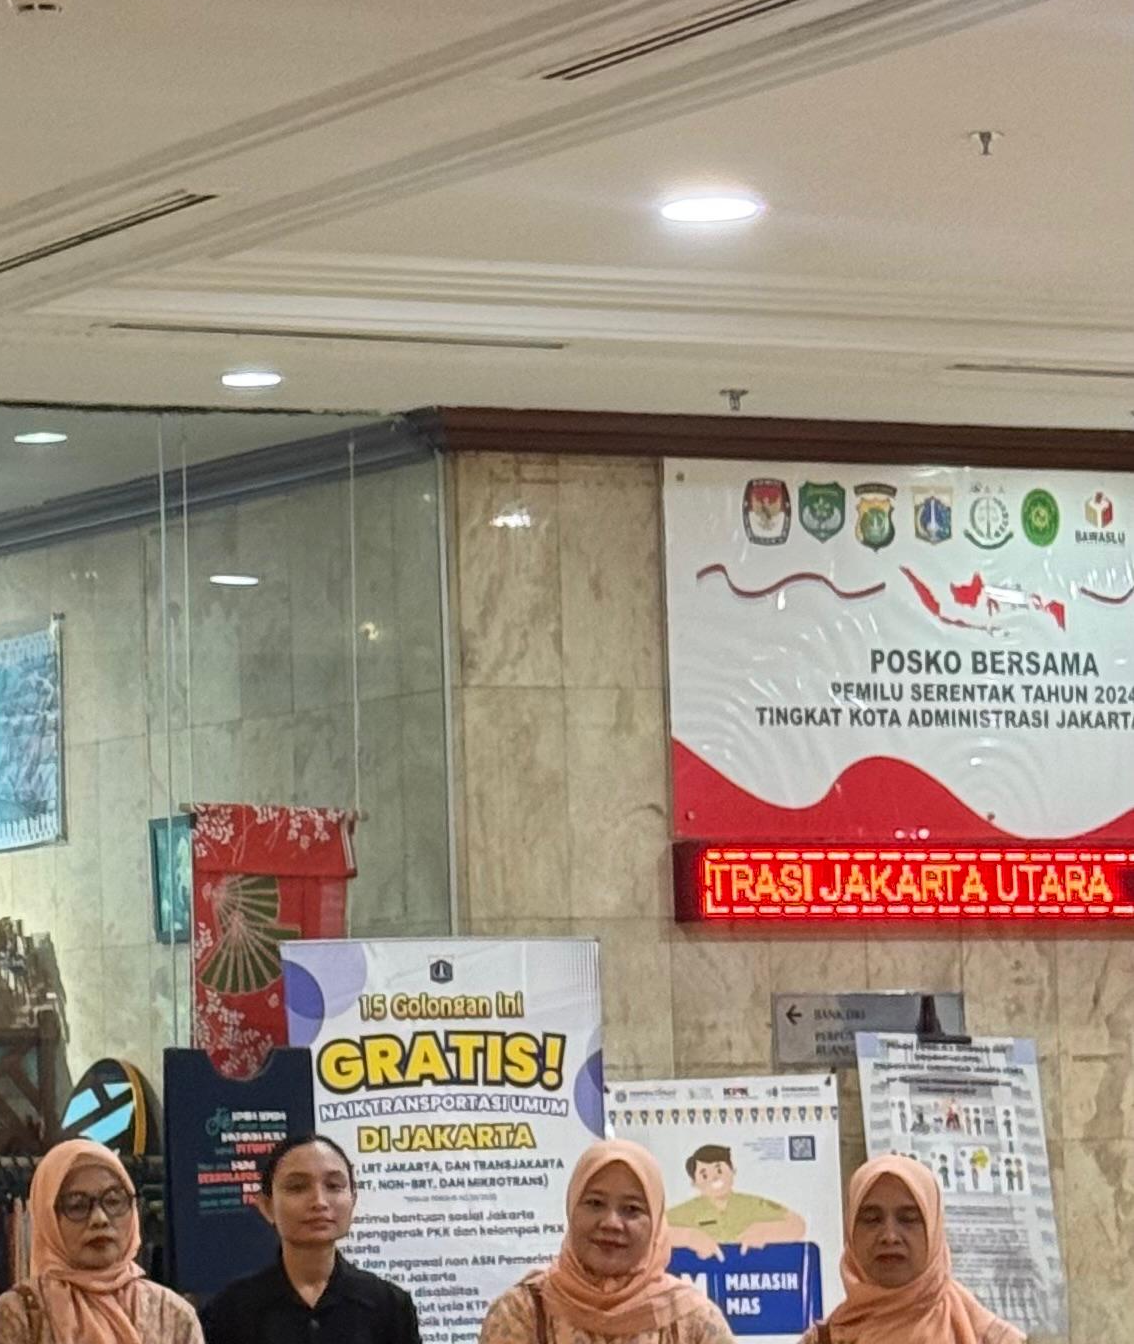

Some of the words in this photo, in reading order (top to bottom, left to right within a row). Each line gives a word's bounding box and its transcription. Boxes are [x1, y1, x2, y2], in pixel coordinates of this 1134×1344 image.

[1074, 530, 1126, 545] BAWASLU
[870, 648, 962, 675] POSKO
[971, 650, 1100, 677] BERSAMA
[831, 682, 903, 702] PEMILU
[911, 683, 1015, 703] SERENTAK
[1021, 684, 1088, 704] TAHUN
[1094, 685, 1134, 705] 2024
[756, 706, 842, 727] TINGKAT
[849, 707, 902, 727] KOTA
[907, 708, 1049, 730] ADMINISTRASI
[1056, 709, 1134, 731] JAKART
[710, 863, 814, 903] TRASI
[819, 863, 989, 902] JAKARTA
[996, 863, 1114, 902] UTARA
[359, 993, 387, 1022] 15
[391, 991, 493, 1020] Golongan
[317, 1030, 567, 1094] GRATIS!
[320, 1100, 369, 1122] NAIK
[370, 1094, 510, 1116] TRANSPORTASI
[511, 1096, 568, 1117] UMUM
[358, 1125, 391, 1153] DI
[392, 1122, 537, 1152] JAKARTA
[473, 1158, 565, 1171] TRANSJAKARTA
[486, 1209, 535, 1221] Jakarta
[725, 1272, 799, 1291] MAKASIH
[726, 1297, 761, 1315] MAS
